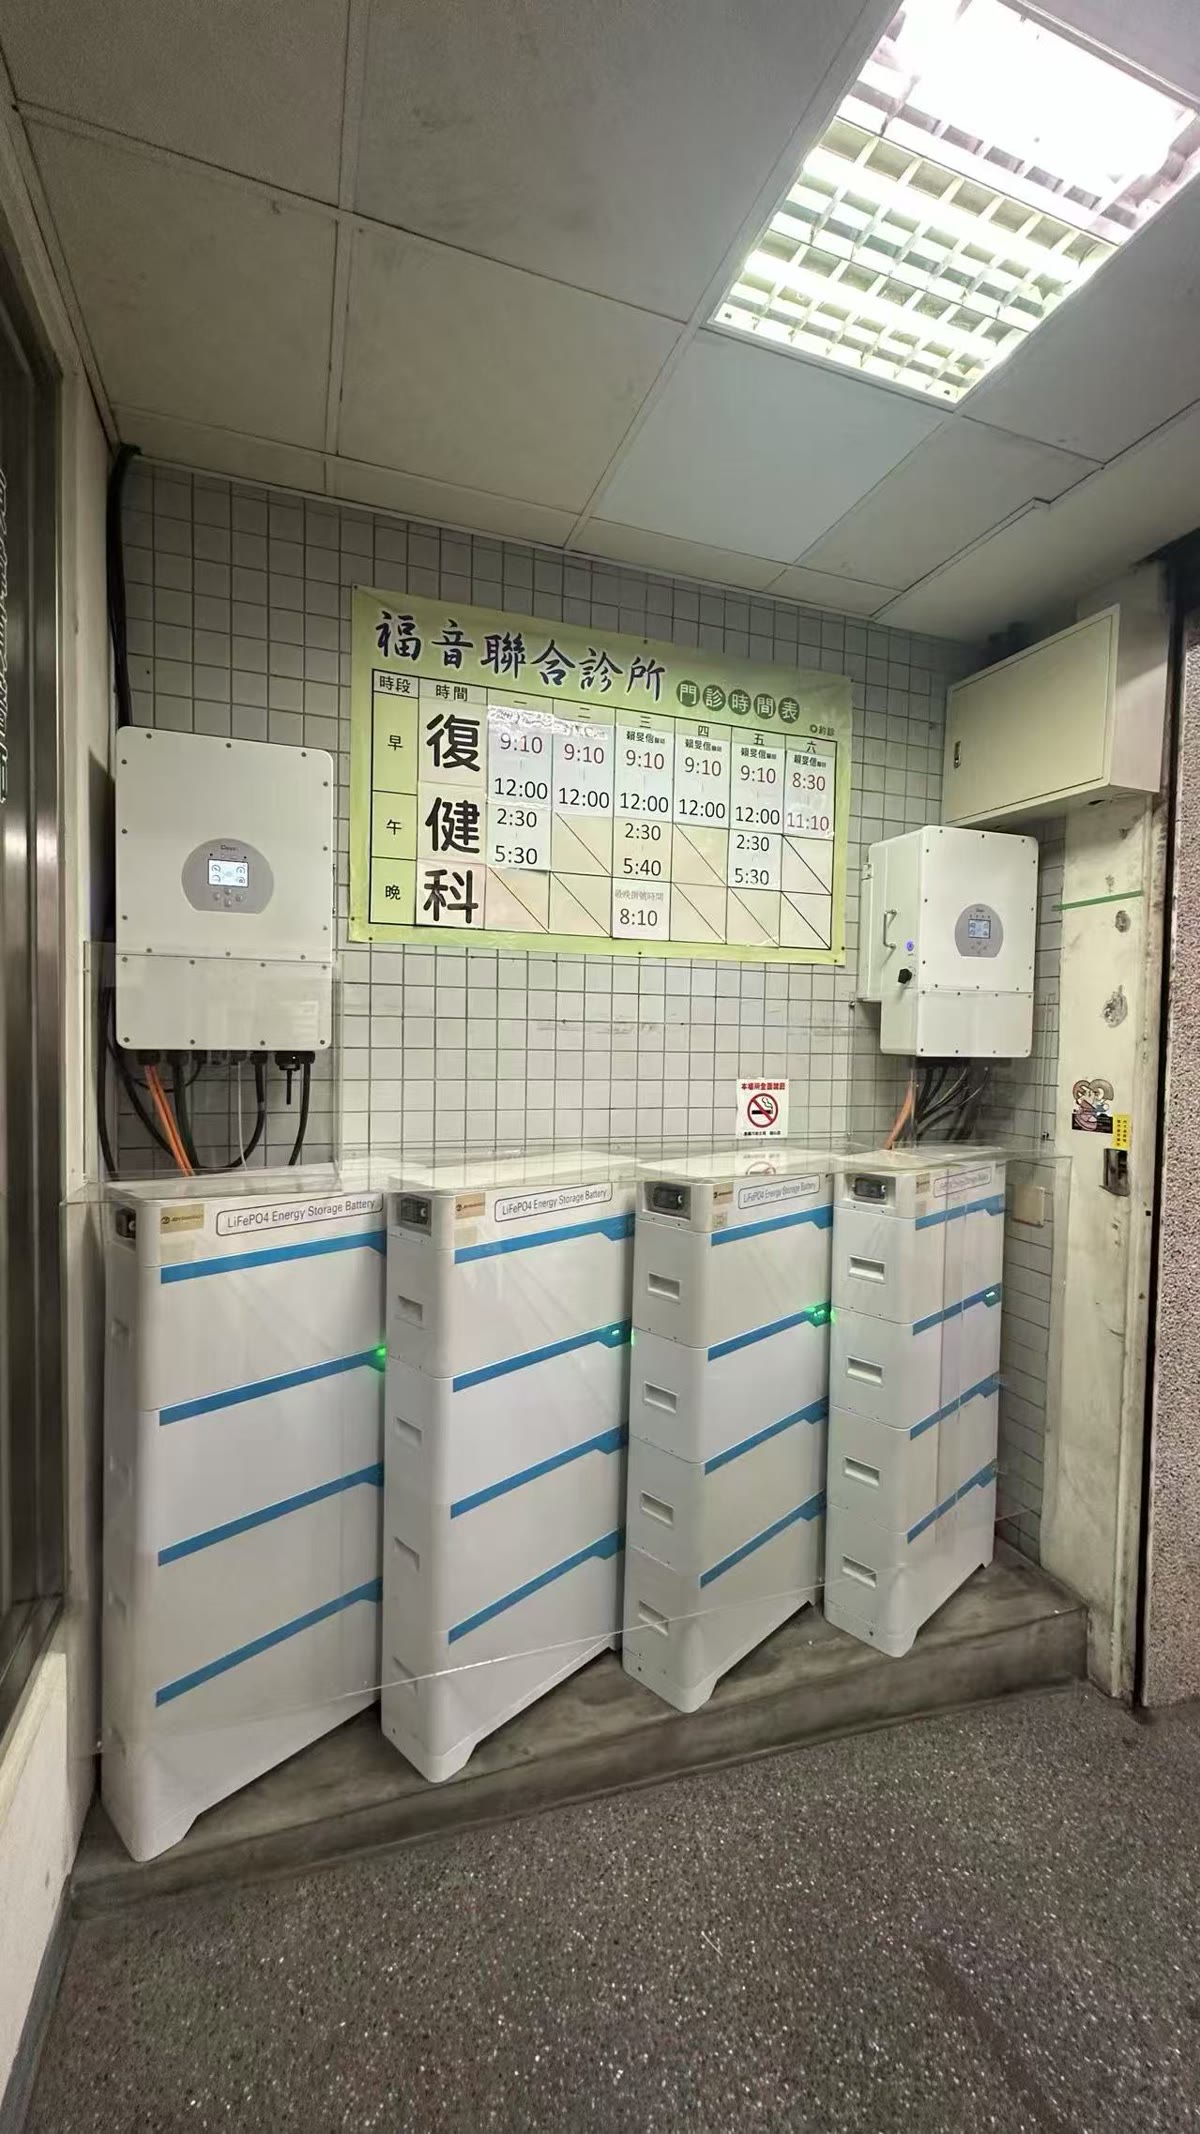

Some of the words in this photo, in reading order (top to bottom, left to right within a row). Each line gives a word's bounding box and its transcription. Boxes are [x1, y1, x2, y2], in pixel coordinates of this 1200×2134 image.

[375, 611, 665, 702] 福音聯合診所
[379, 675, 411, 693] 時段
[435, 684, 468, 701] 時間
[678, 682, 799, 722] 門診時間表
[578, 707, 591, 719] 二
[639, 715, 651, 729] 三
[697, 725, 709, 737] 四
[753, 733, 765, 746] 五
[387, 735, 403, 751] 早
[500, 732, 543, 754] 9:10
[806, 741, 817, 754] 六
[563, 743, 604, 765] 9:10
[626, 749, 665, 770] 9:10
[684, 756, 722, 777] 9:10
[740, 765, 776, 784] 9:10
[494, 777, 548, 800] 12:00
[792, 772, 826, 792] 8:30
[558, 787, 610, 809] 12:00
[620, 792, 669, 814] 12:00
[423, 714, 480, 923] 復健科
[496, 808, 537, 828] 2:30
[678, 798, 726, 819] 12:00
[735, 806, 780, 826] 12:00
[386, 819, 402, 835] 午
[624, 822, 661, 841] 2:30
[787, 812, 829, 832] 11:10
[736, 834, 770, 852] 2:30
[495, 845, 538, 865] 5:30
[623, 858, 662, 877] 5:40
[734, 868, 770, 886] 5:30
[385, 885, 401, 901] 晚
[619, 908, 658, 927] 8:10
[501, 1201, 532, 1215] LiFePO4
[533, 1197, 557, 1211] Energy
[558, 1192, 584, 1207] Storage
[585, 1187, 607, 1201] Battery
[227, 1212, 269, 1229] LiFePO4
[271, 1208, 306, 1223] Energy
[307, 1202, 343, 1218] Storage
[345, 1197, 376, 1211] Battery
